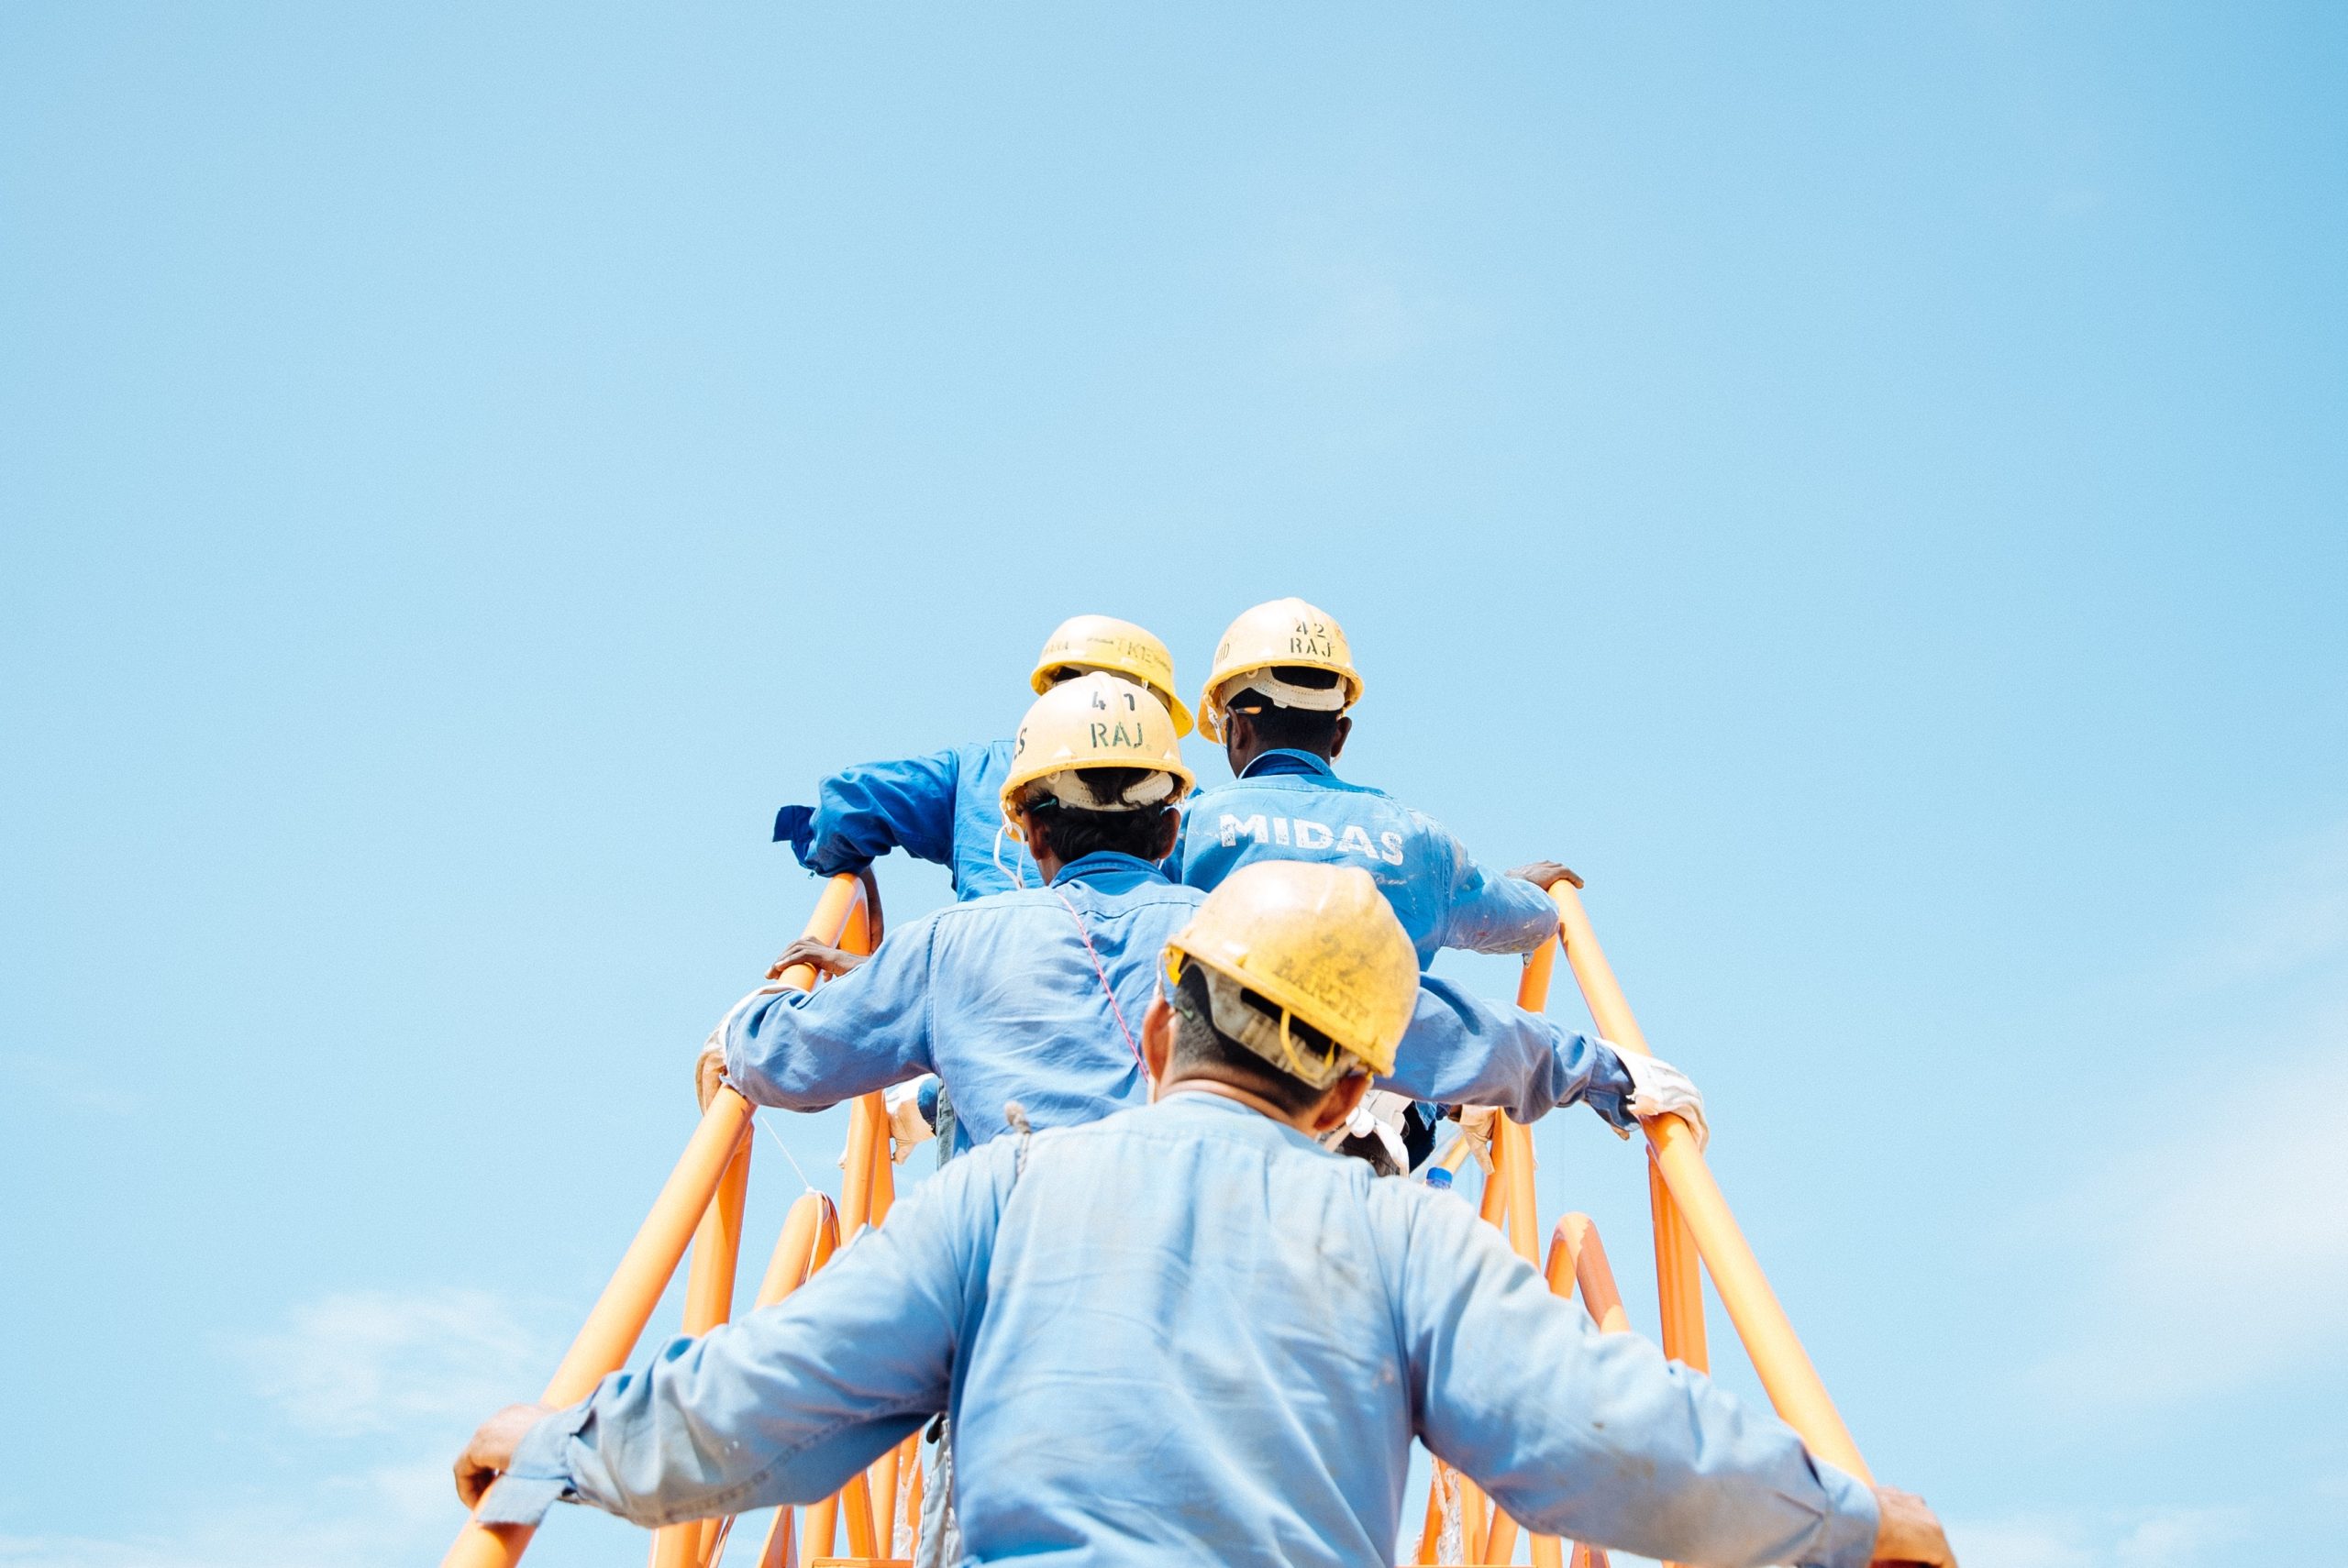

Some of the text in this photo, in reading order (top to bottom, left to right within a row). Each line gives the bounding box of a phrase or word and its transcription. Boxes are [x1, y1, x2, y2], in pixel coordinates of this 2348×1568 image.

[1290, 637, 1331, 657] RAJ
[1090, 722, 1144, 749] RAJ
[1219, 813, 1404, 867] MIDAS
